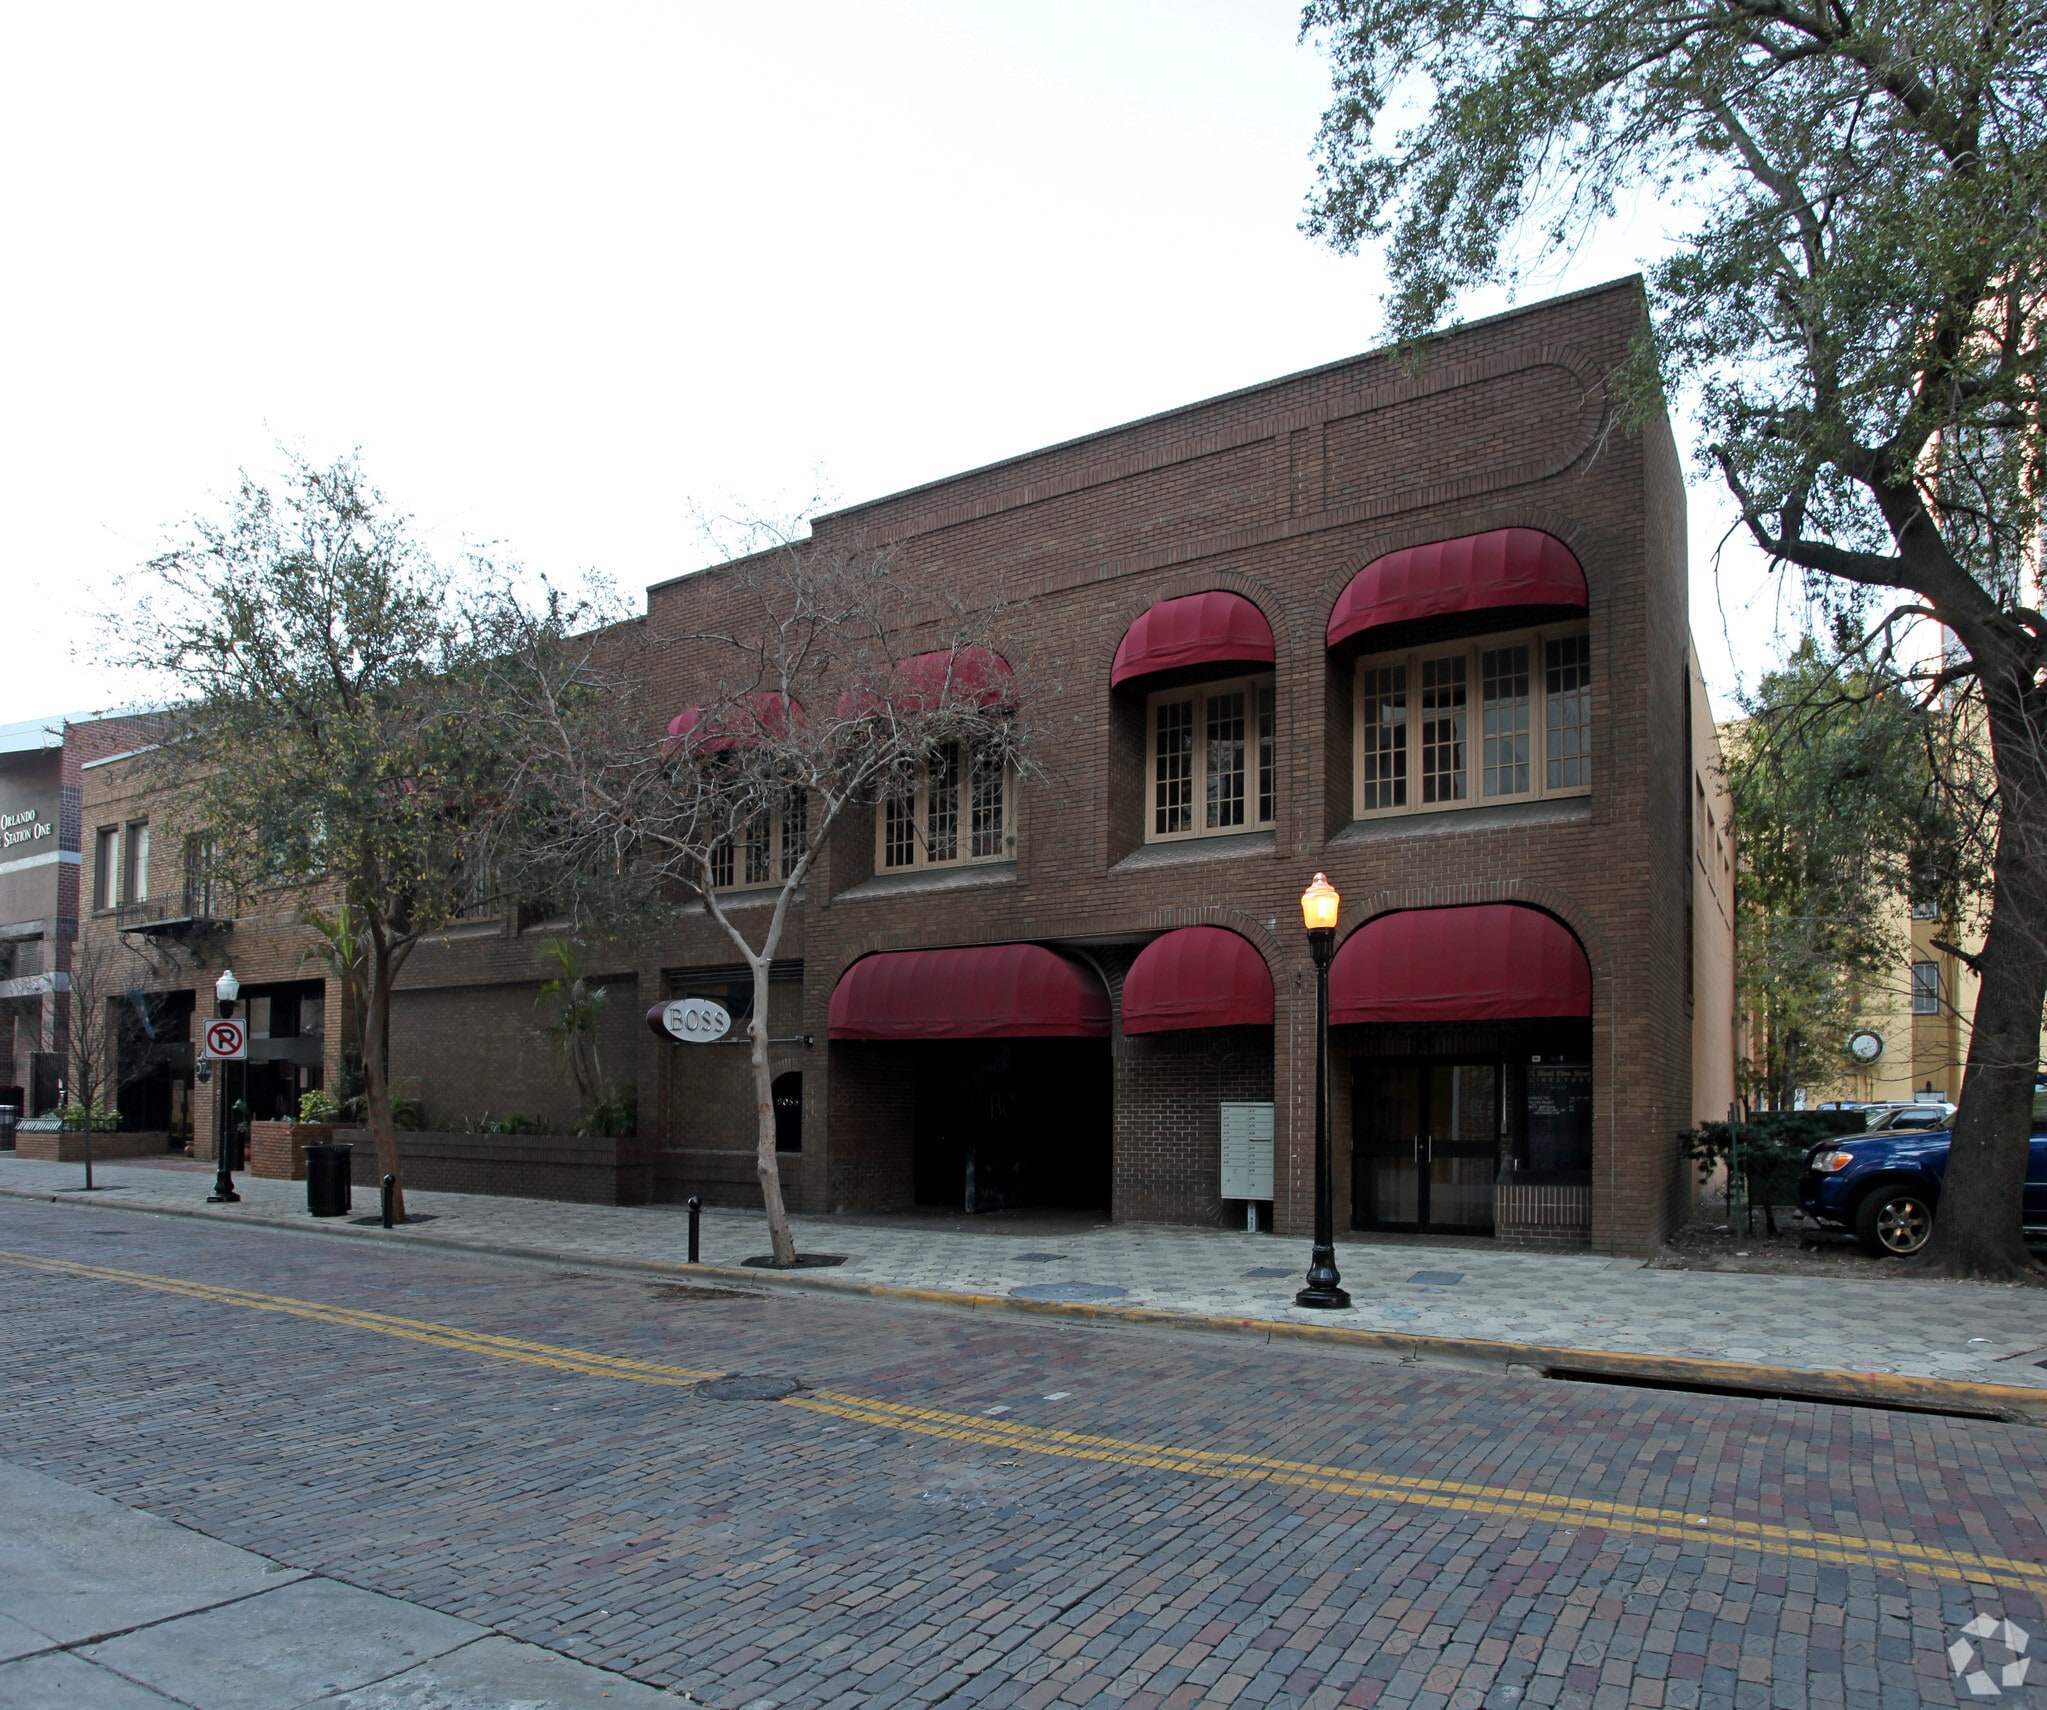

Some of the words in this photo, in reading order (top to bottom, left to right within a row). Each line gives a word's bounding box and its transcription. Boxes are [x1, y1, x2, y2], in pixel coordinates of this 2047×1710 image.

[1, 809, 36, 830] ORLANDO
[4, 828, 32, 848] STATION
[34, 823, 52, 840] ONE
[669, 1008, 725, 1033] BOSS
